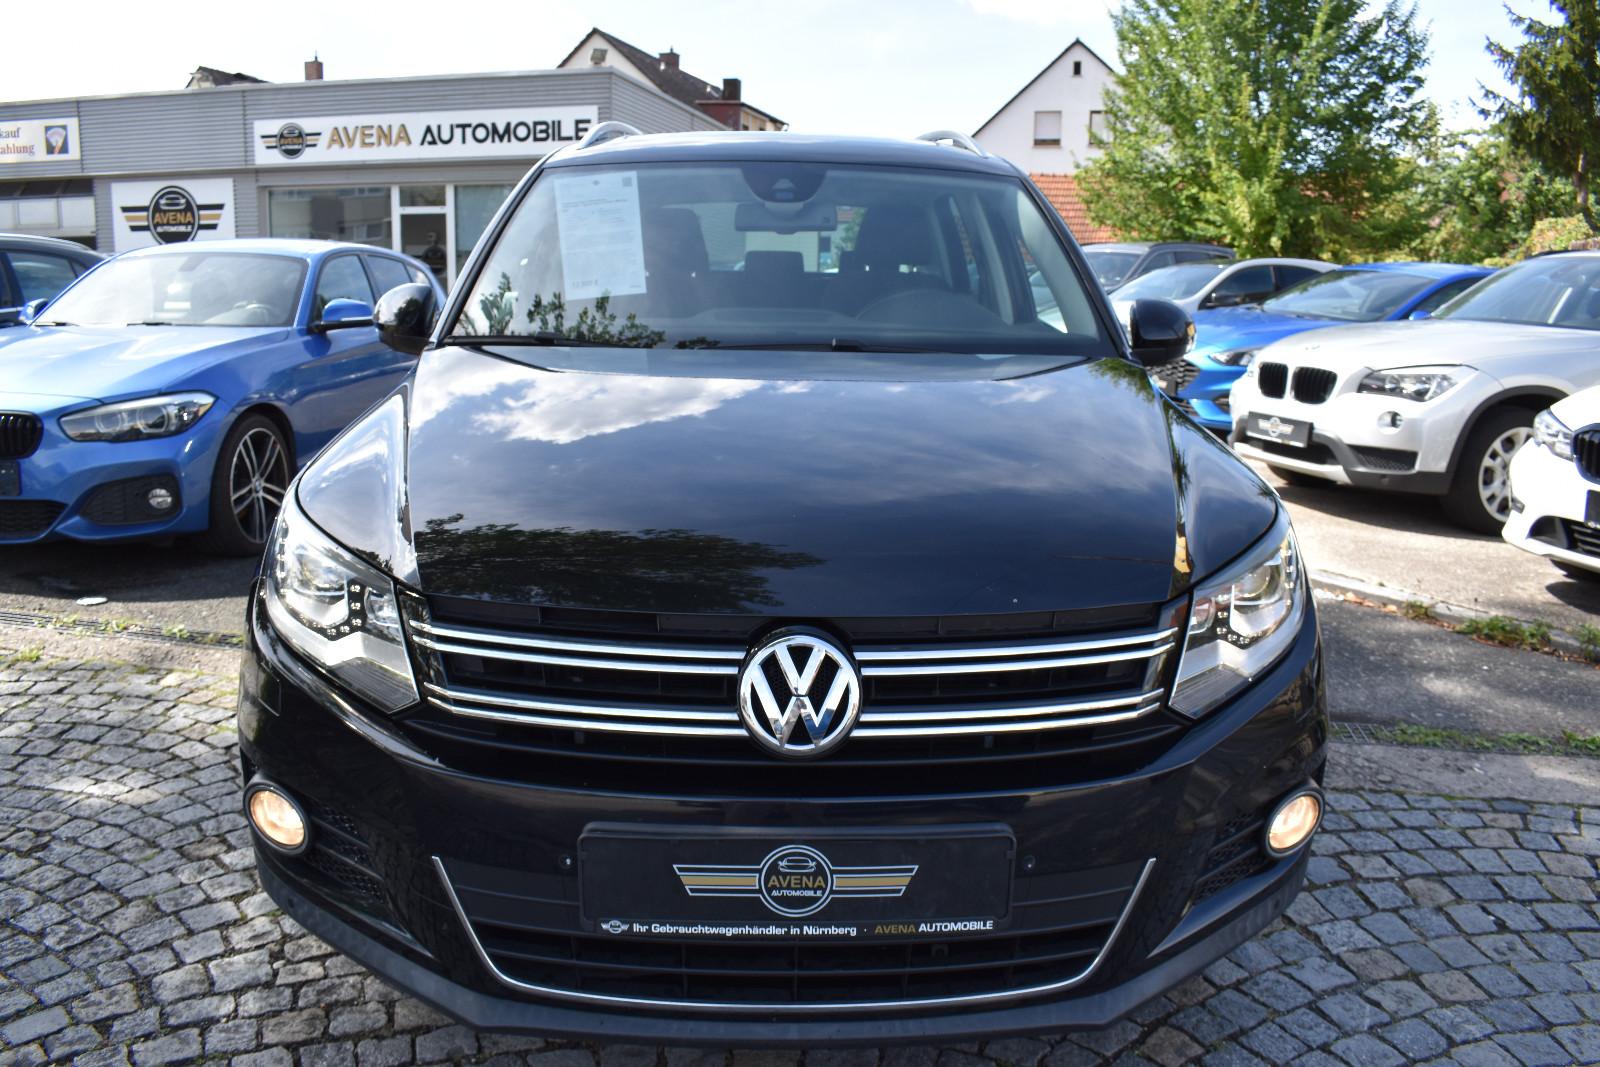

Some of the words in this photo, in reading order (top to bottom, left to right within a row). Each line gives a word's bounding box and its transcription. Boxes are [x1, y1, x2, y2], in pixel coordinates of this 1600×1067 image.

[326, 124, 412, 149] AVENA
[420, 119, 592, 146] AUTOMOBILE
[153, 211, 194, 225] AVENA
[741, 635, 860, 753] VW
[767, 874, 826, 889] AVENA
[770, 889, 823, 897] AUTOMOBILE
[632, 923, 649, 933] Ihr
[651, 923, 788, 936] Gebrauchtwagenhändler
[790, 926, 800, 935] in
[803, 925, 857, 937] Nürnberg
[874, 923, 916, 935] AVENA
[918, 920, 994, 933] AUTOMOBILE
